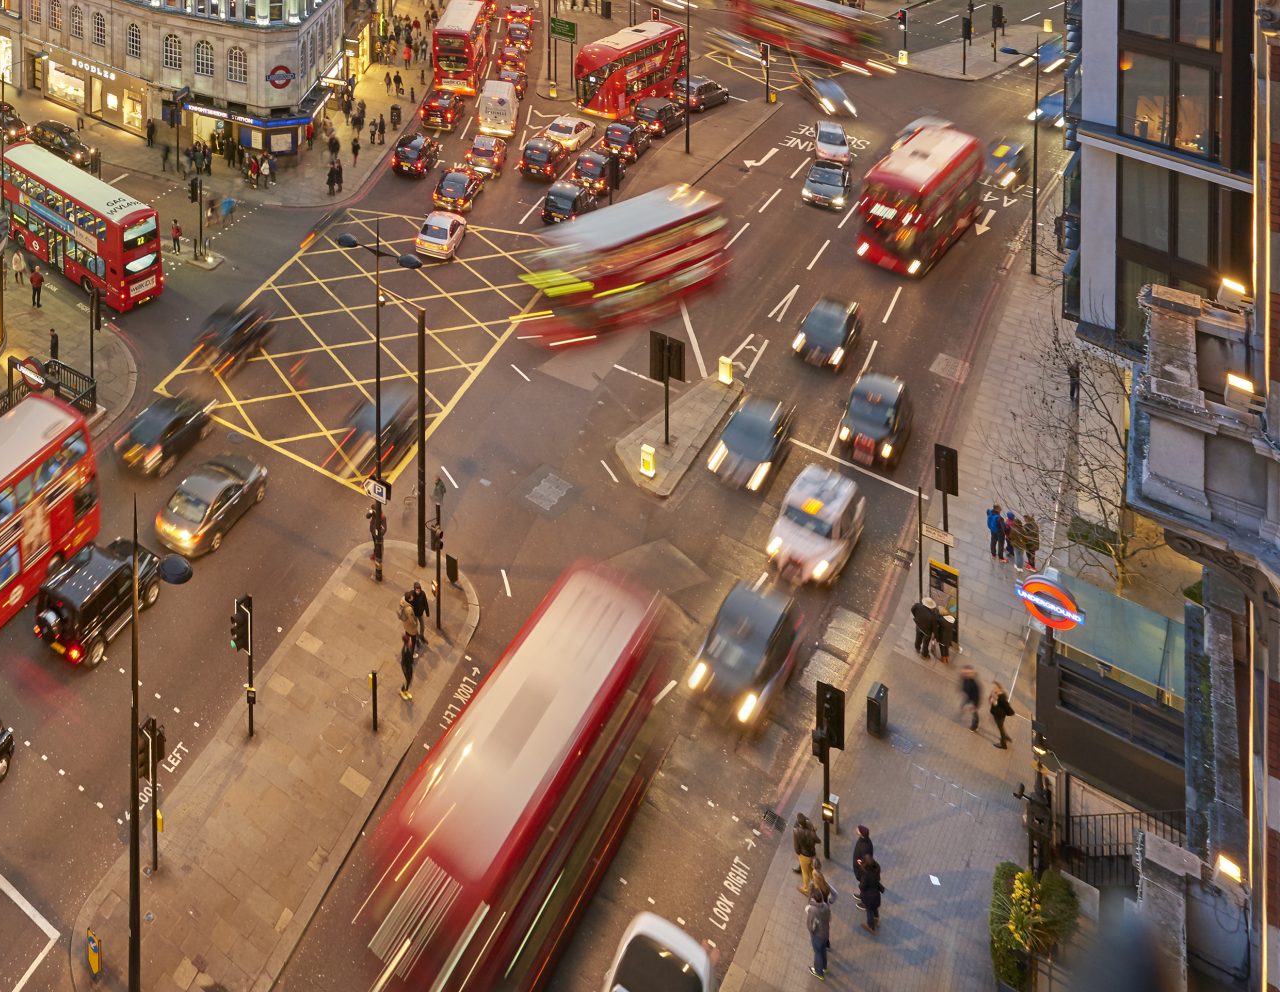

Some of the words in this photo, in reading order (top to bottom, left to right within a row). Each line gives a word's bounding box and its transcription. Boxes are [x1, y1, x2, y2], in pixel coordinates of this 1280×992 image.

[71, 58, 116, 81] BOODLES
[231, 114, 254, 125] STATION
[137, 237, 145, 246] 22
[1017, 588, 1082, 623] UNDERGROUND
[453, 676, 478, 705] LOOK
[161, 741, 189, 773] LEFT
[708, 893, 735, 930] LOOK
[723, 855, 750, 895] RIGHT
